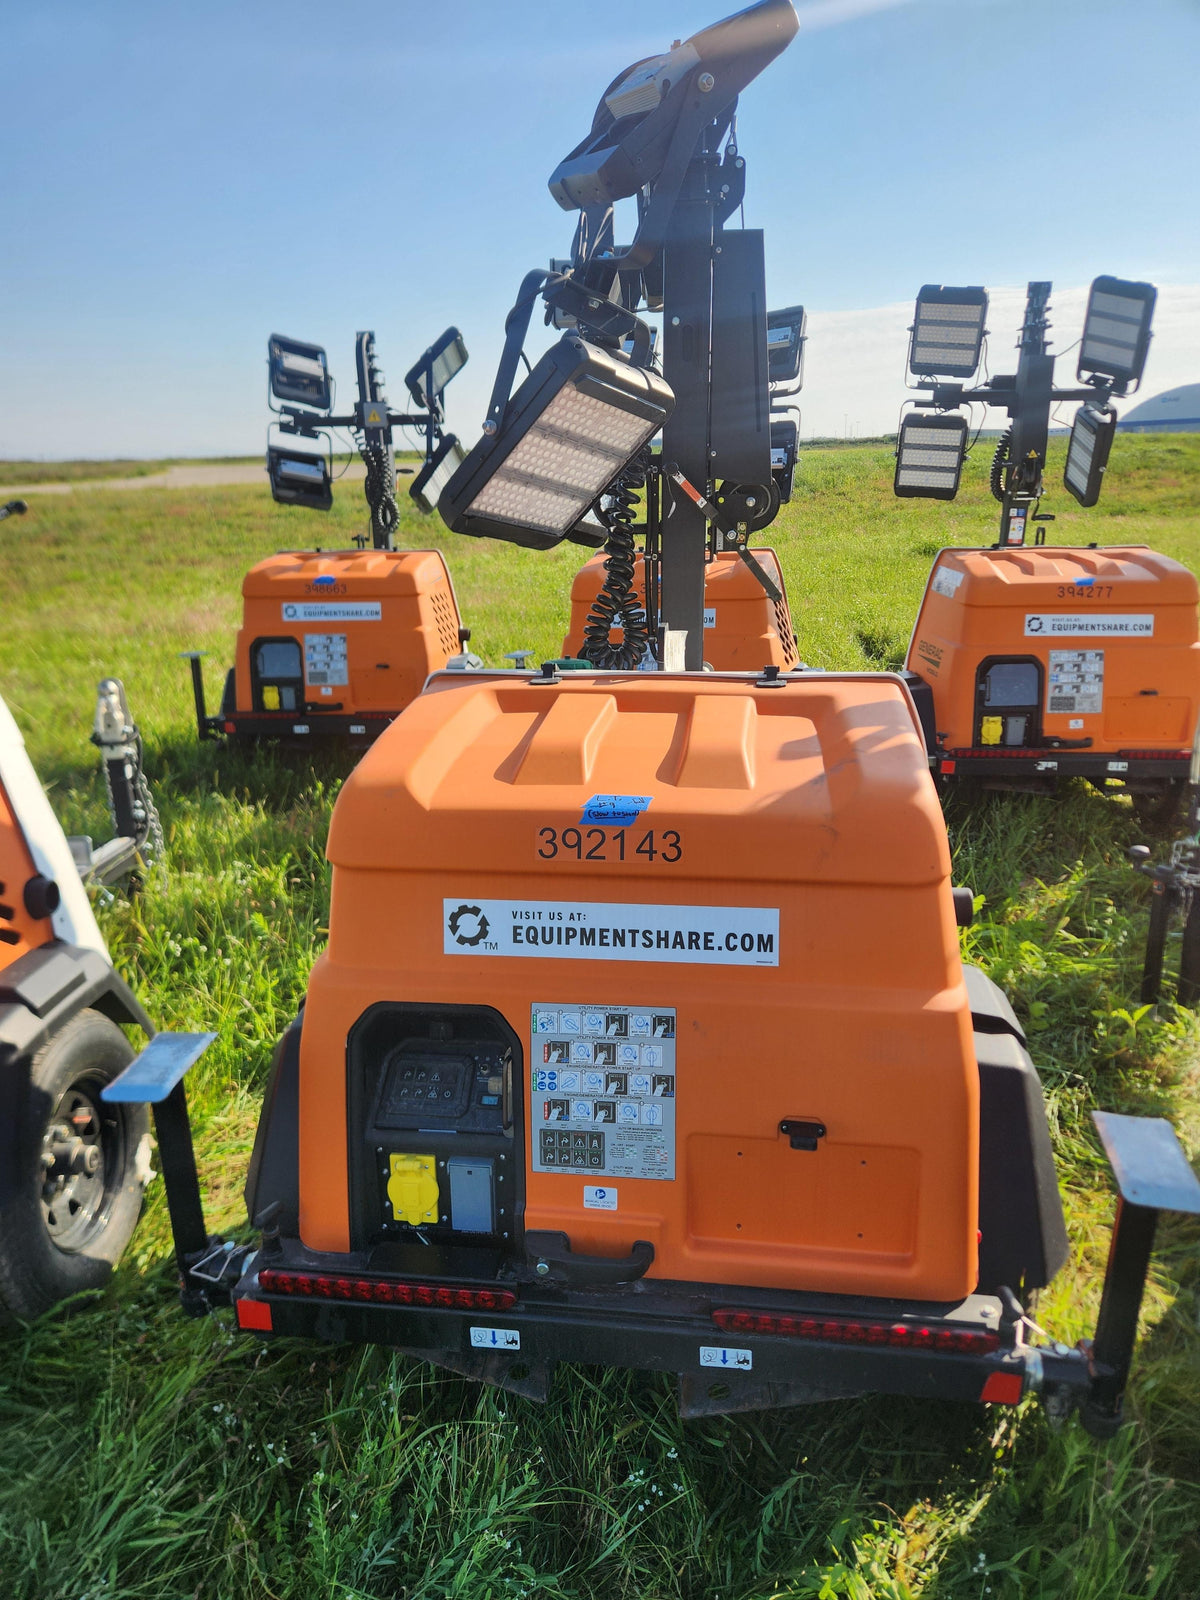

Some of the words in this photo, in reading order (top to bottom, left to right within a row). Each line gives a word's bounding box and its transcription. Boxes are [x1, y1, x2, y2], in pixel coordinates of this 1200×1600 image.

[1057, 586, 1113, 599] 394277
[1051, 623, 1152, 632] EQUIPMENTSHARE.COM
[538, 827, 683, 863] 392143
[511, 910, 543, 920] VISIT
[549, 912, 563, 921] US
[569, 912, 587, 921] AT:
[512, 925, 774, 953] EQUIPMENTSHARE.COM
[483, 941, 498, 950] TM
